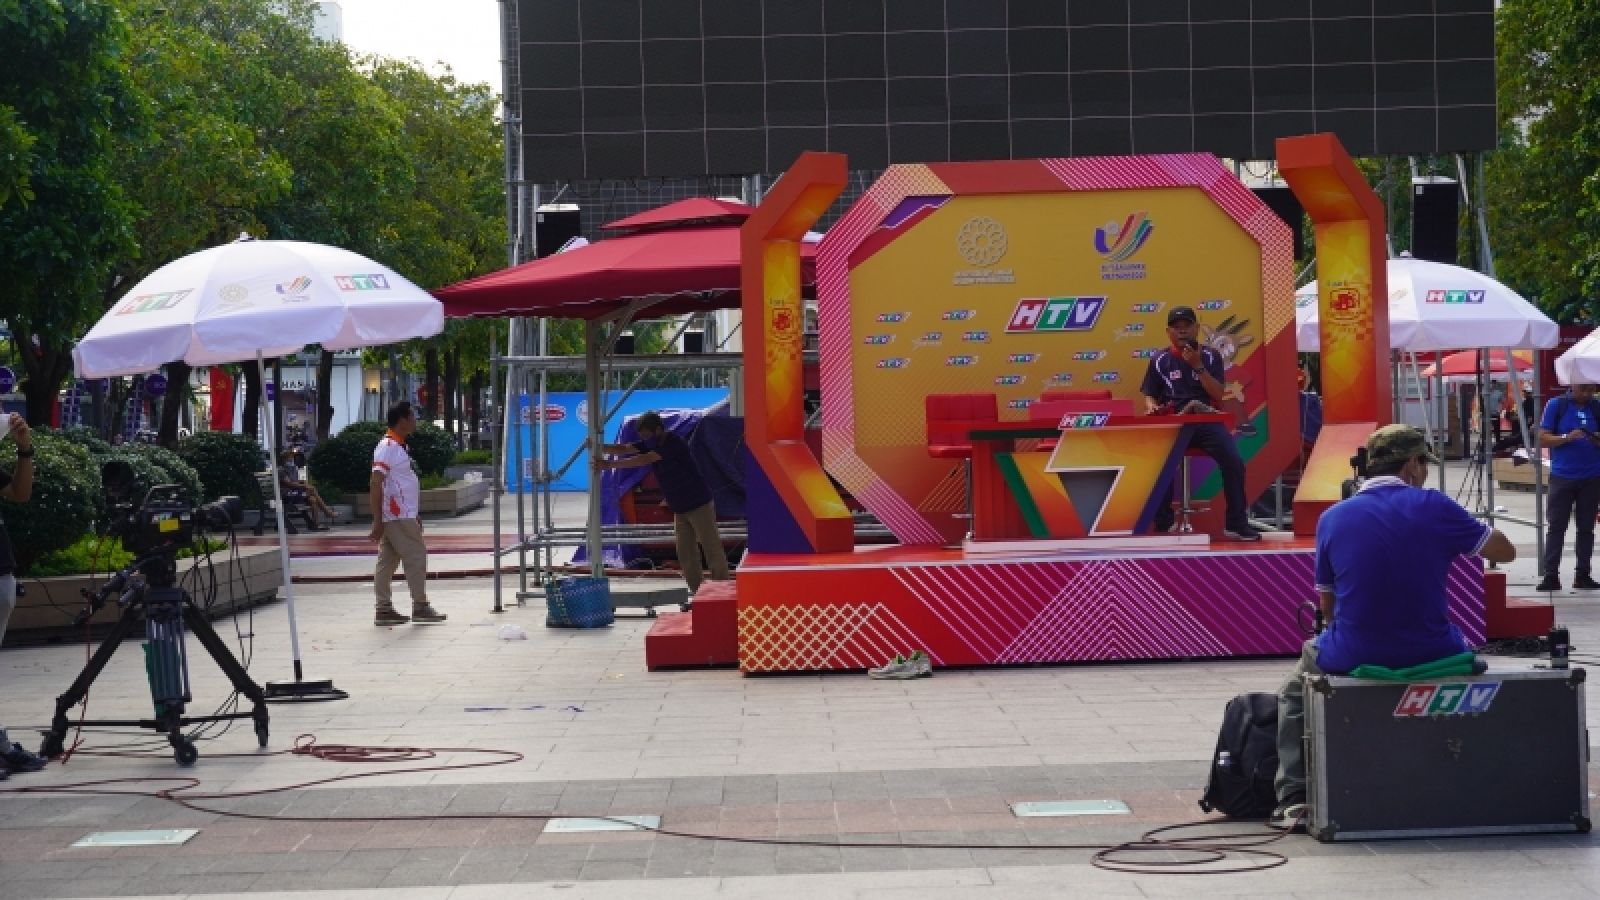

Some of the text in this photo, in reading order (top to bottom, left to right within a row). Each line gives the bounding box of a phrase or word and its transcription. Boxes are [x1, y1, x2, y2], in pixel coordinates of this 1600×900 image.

[335, 275, 388, 290] HTV
[1428, 290, 1483, 302] HTV
[1010, 299, 1102, 329] HTV
[1060, 413, 1109, 429] HTV
[1397, 684, 1498, 713] HTV
